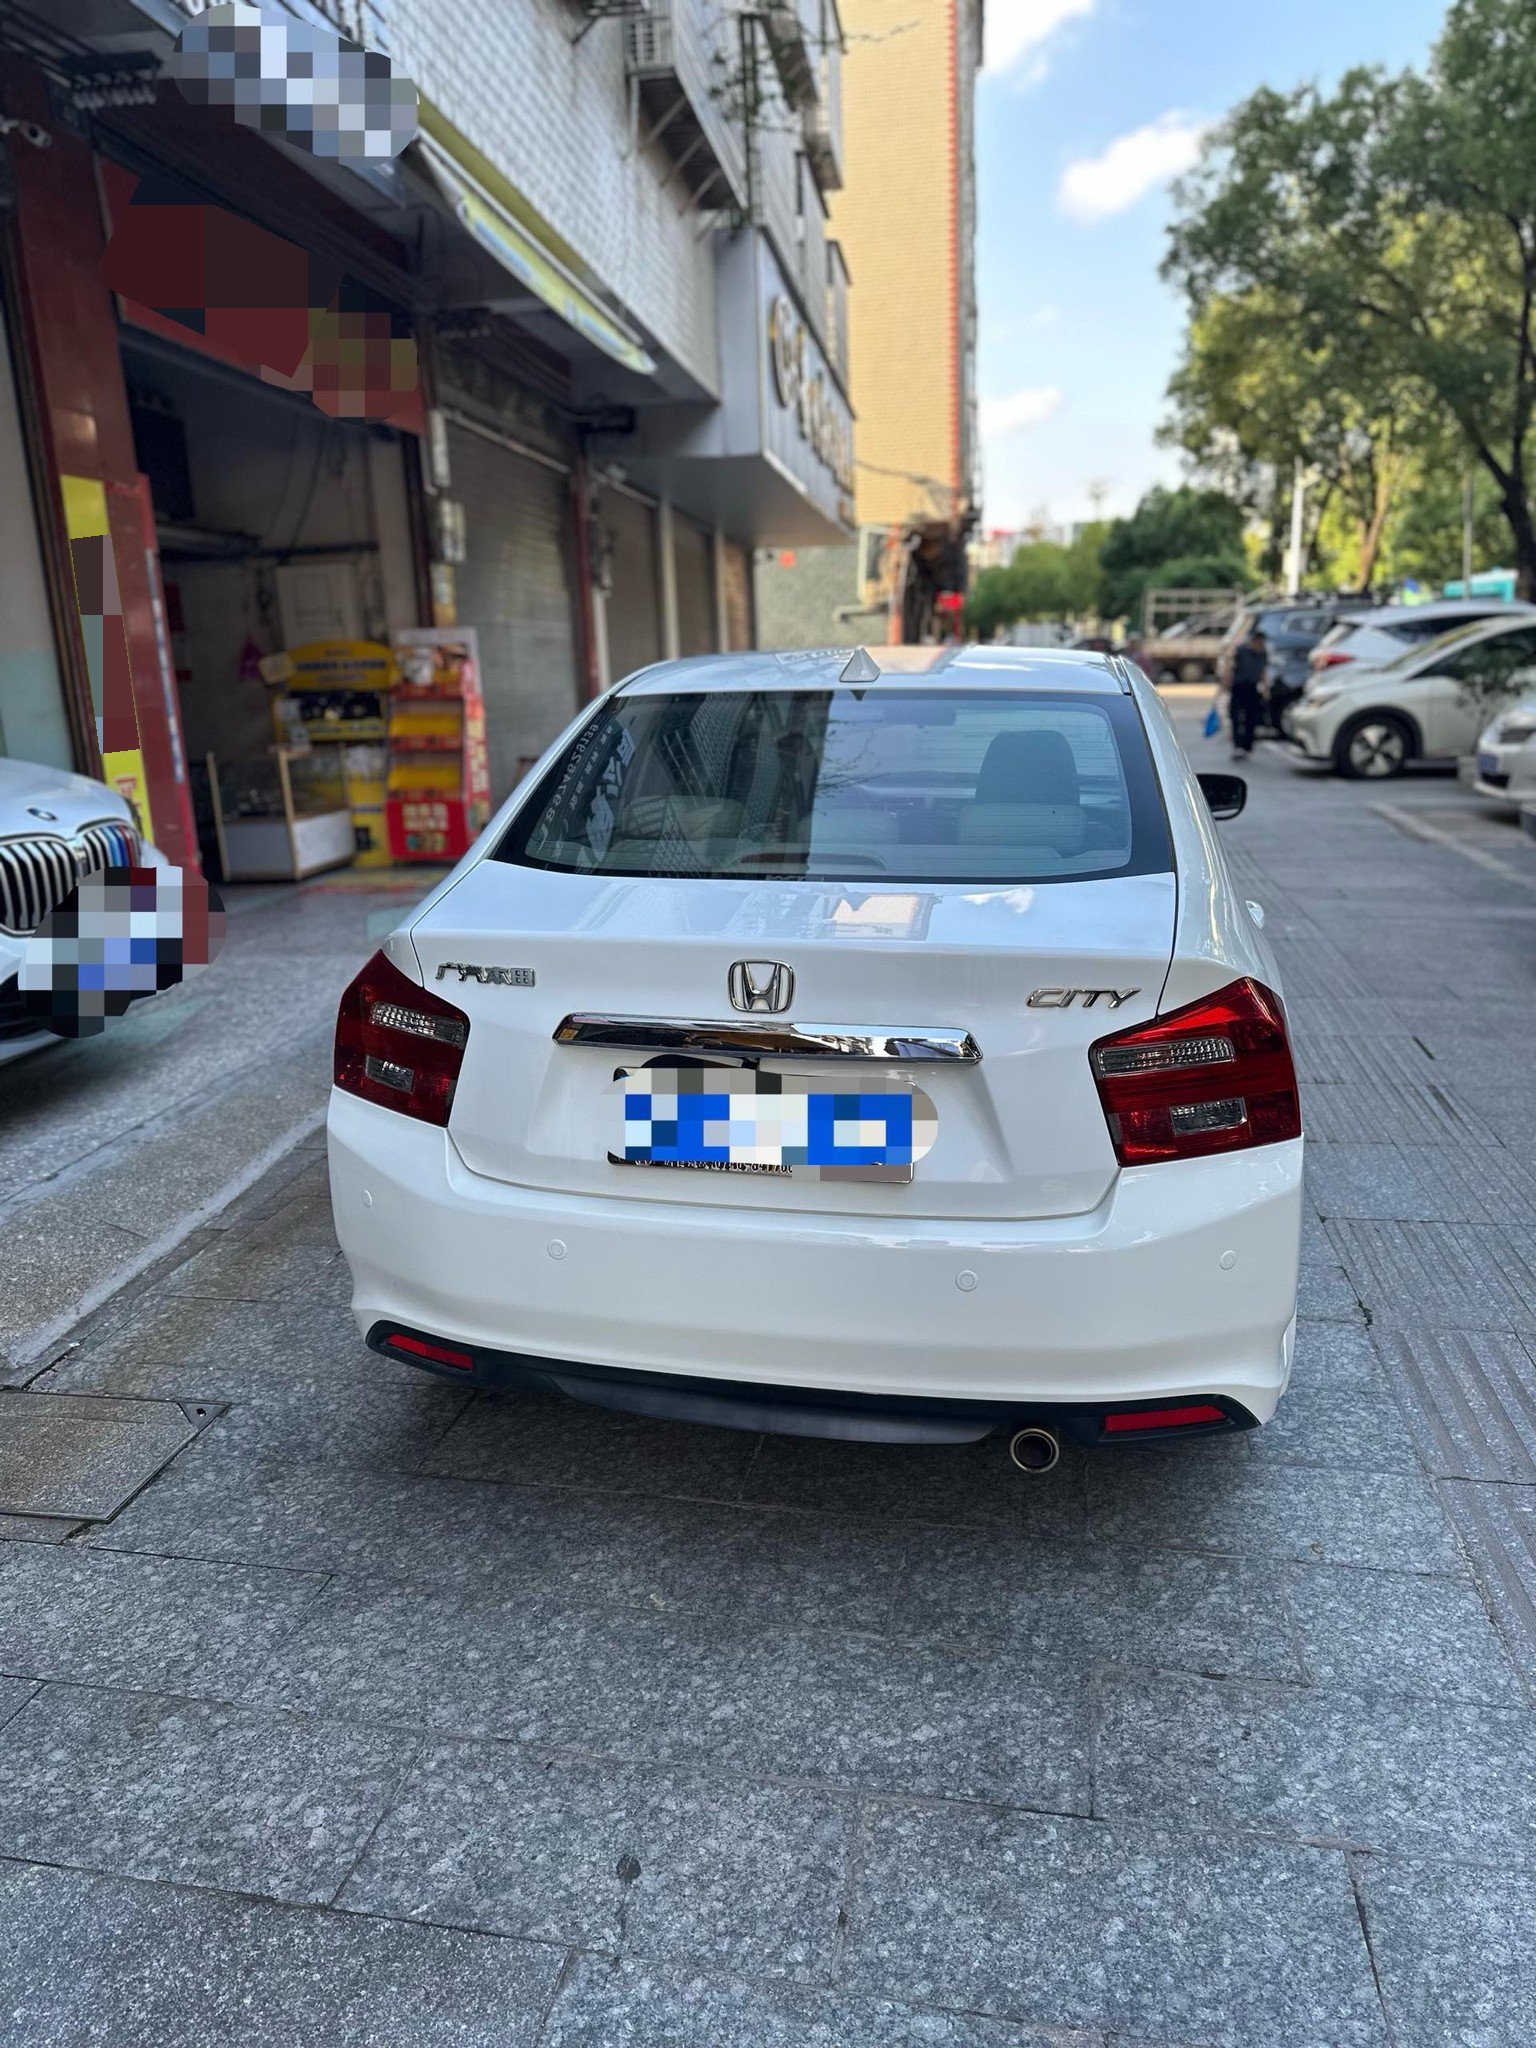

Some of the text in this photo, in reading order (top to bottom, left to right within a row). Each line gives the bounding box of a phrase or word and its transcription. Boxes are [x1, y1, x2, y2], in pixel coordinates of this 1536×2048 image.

[435, 961, 536, 988] 广汽本田
[1026, 987, 1142, 1009] CITY
